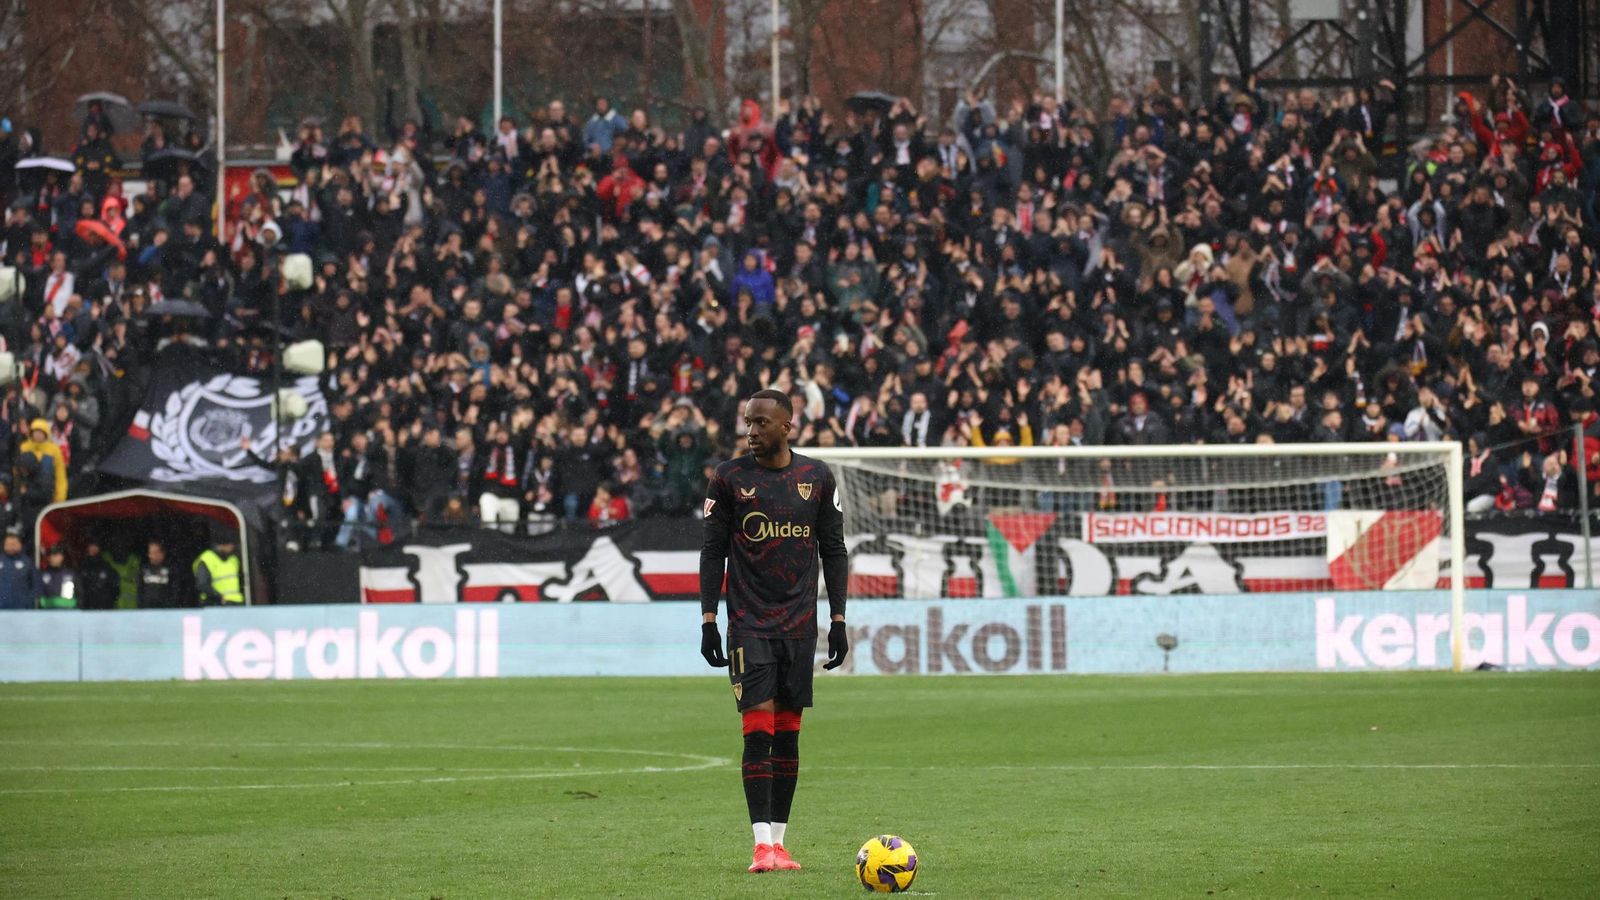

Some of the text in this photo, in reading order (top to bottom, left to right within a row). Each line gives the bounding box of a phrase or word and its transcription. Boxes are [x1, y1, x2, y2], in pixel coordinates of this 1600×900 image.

[752, 519, 811, 539] Midea
[1095, 514, 1291, 537] SANCIONADOS
[182, 608, 499, 679] kerakoll
[815, 604, 1067, 675] rakoll
[729, 646, 745, 676] 11
